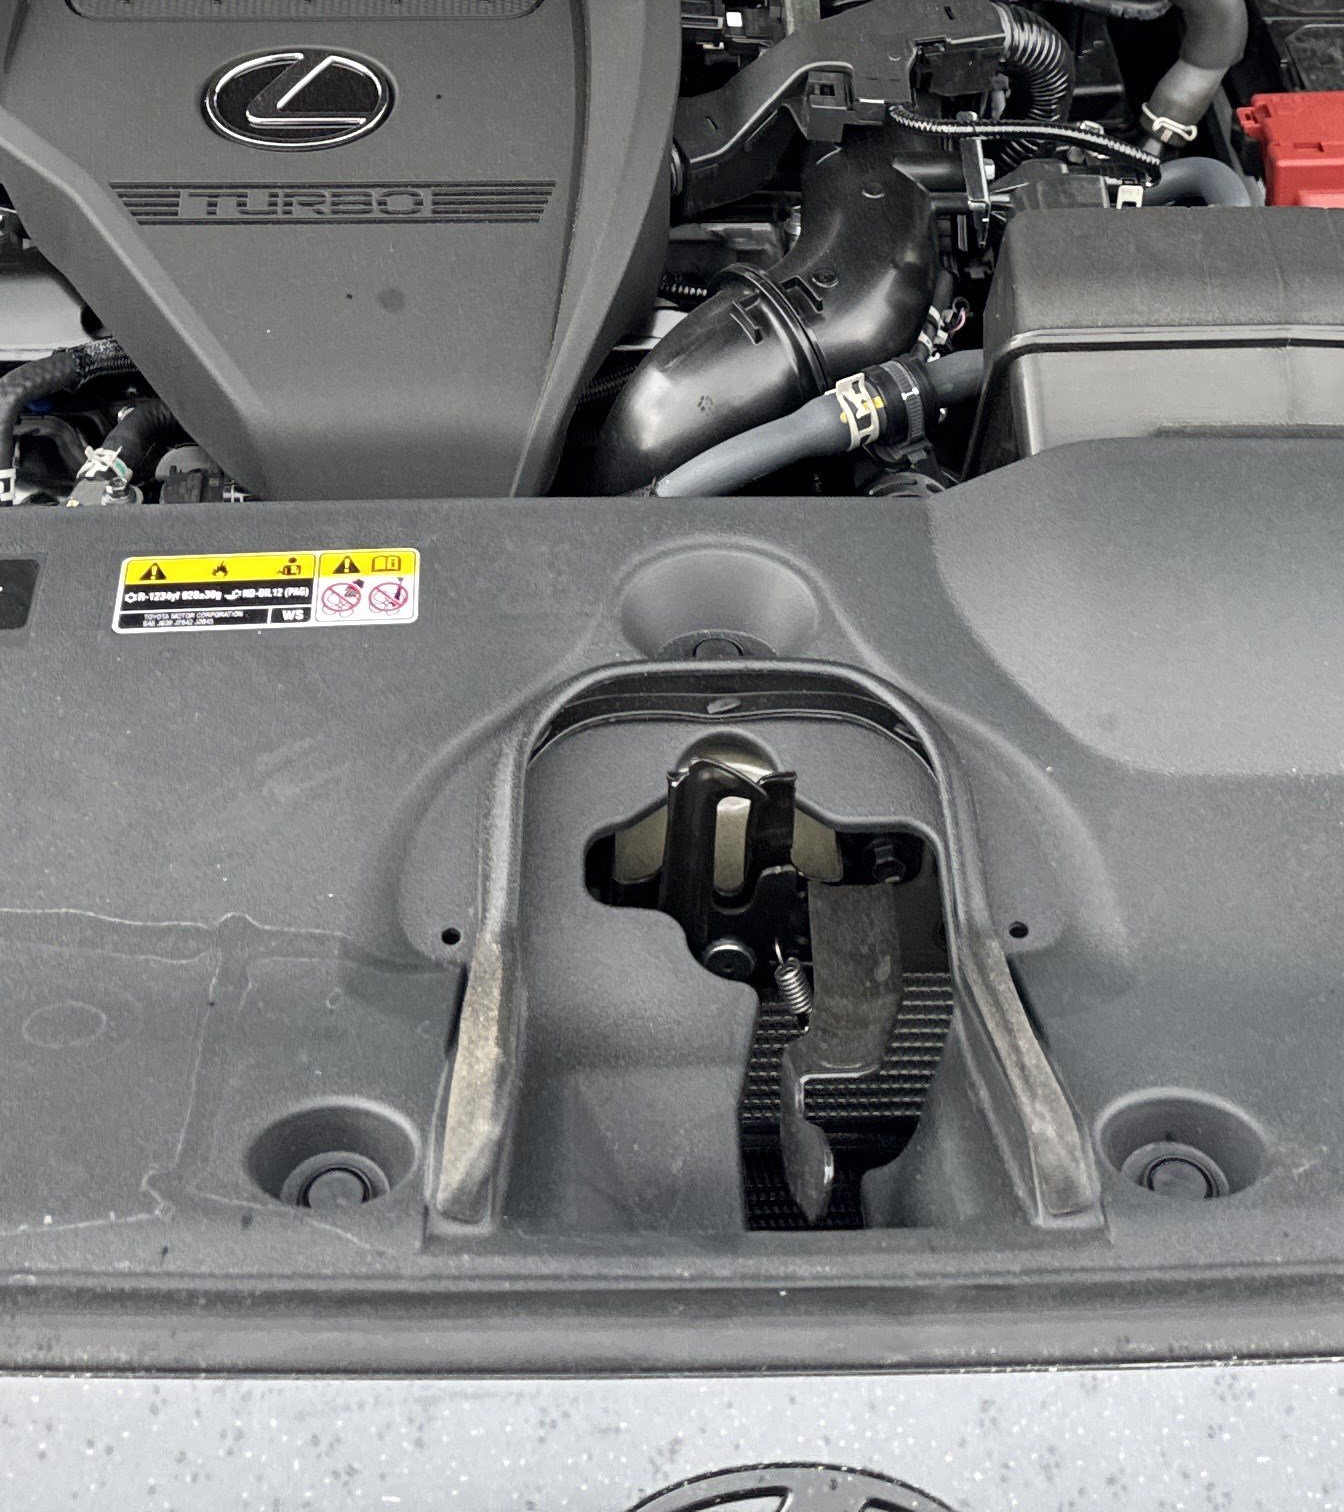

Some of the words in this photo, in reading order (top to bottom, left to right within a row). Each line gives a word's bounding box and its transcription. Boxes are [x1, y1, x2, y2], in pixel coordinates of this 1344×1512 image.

[189, 189, 425, 217] TURBO
[144, 613, 170, 621] TOYOTA
[171, 612, 196, 620] MOTOR
[196, 610, 244, 619] CORPORATION
[282, 609, 305, 621] WS
